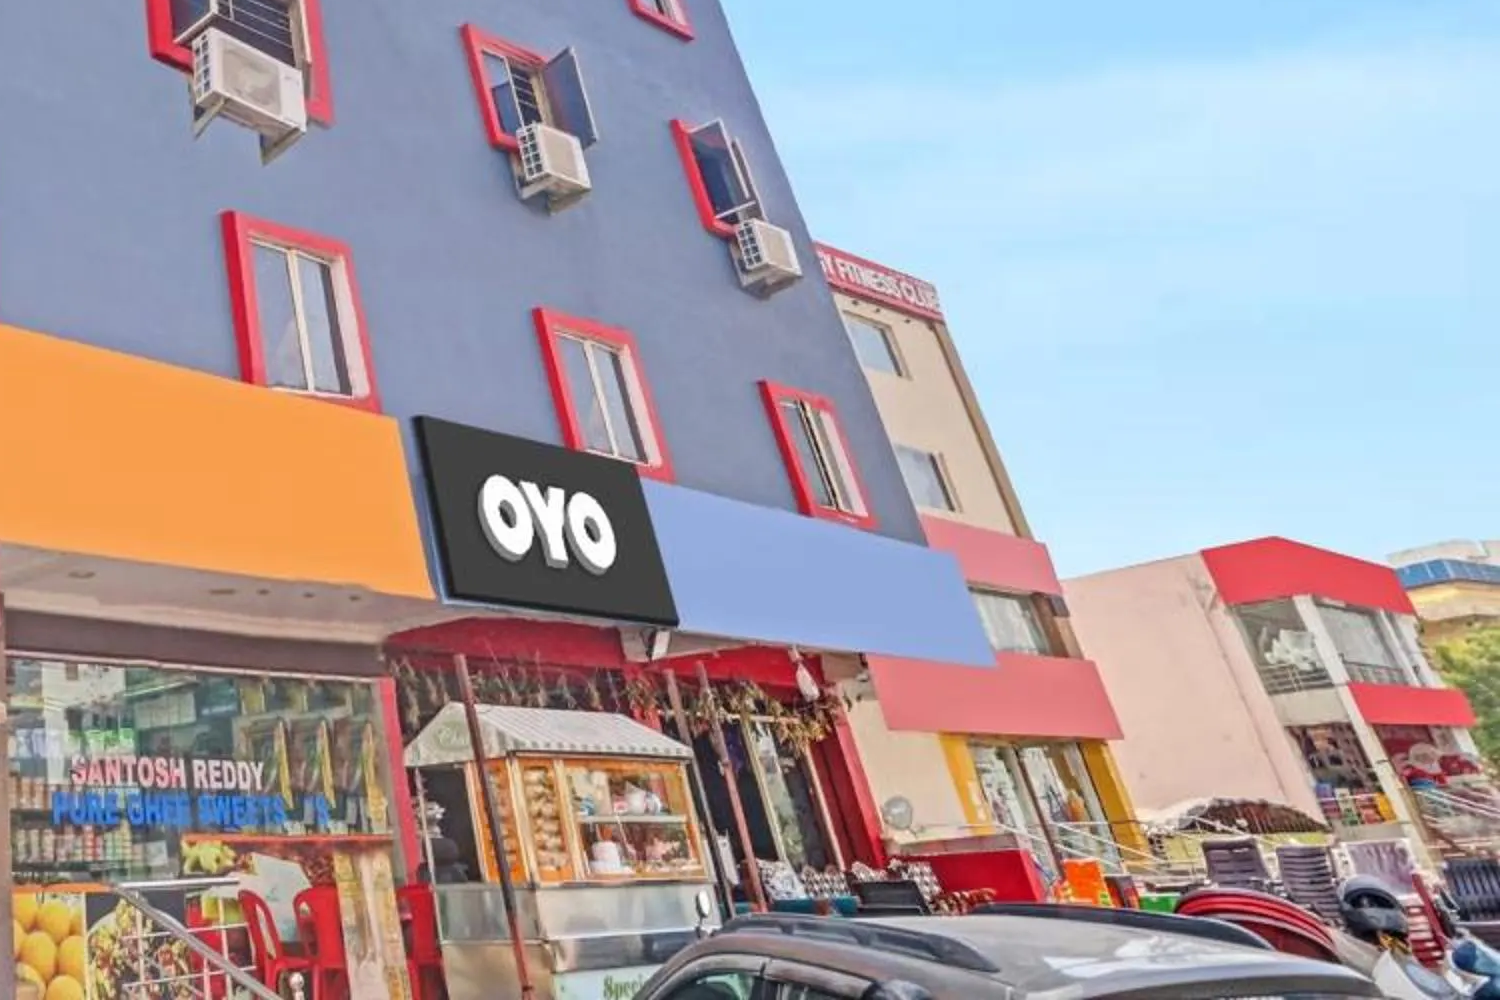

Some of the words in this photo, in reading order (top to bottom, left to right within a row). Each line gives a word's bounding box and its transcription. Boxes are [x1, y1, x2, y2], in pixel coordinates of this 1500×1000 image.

[477, 474, 617, 577] OYO
[71, 754, 187, 788] SANTOSH
[191, 758, 264, 791] REDDY
[51, 790, 121, 826] PURE
